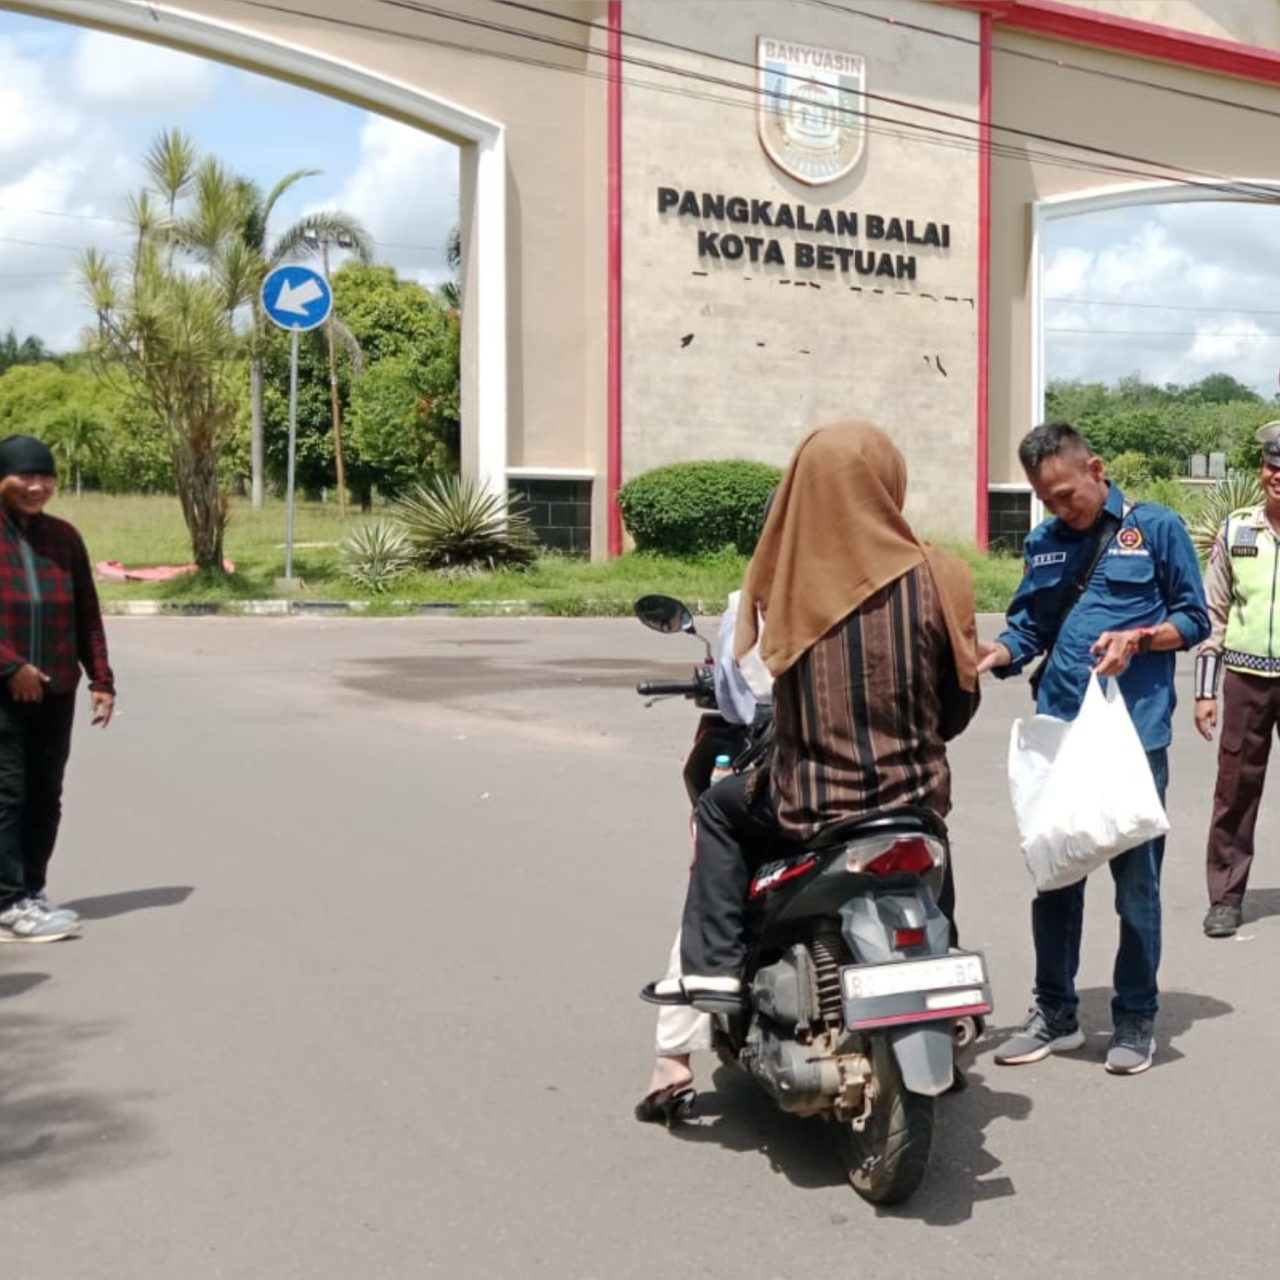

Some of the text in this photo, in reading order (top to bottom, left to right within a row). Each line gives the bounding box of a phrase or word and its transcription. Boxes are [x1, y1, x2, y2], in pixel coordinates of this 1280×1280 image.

[764, 41, 863, 73] BANYUASIN
[657, 186, 950, 248] PANGKALAN BALAI
[697, 229, 917, 281] KOTA BETUAH
